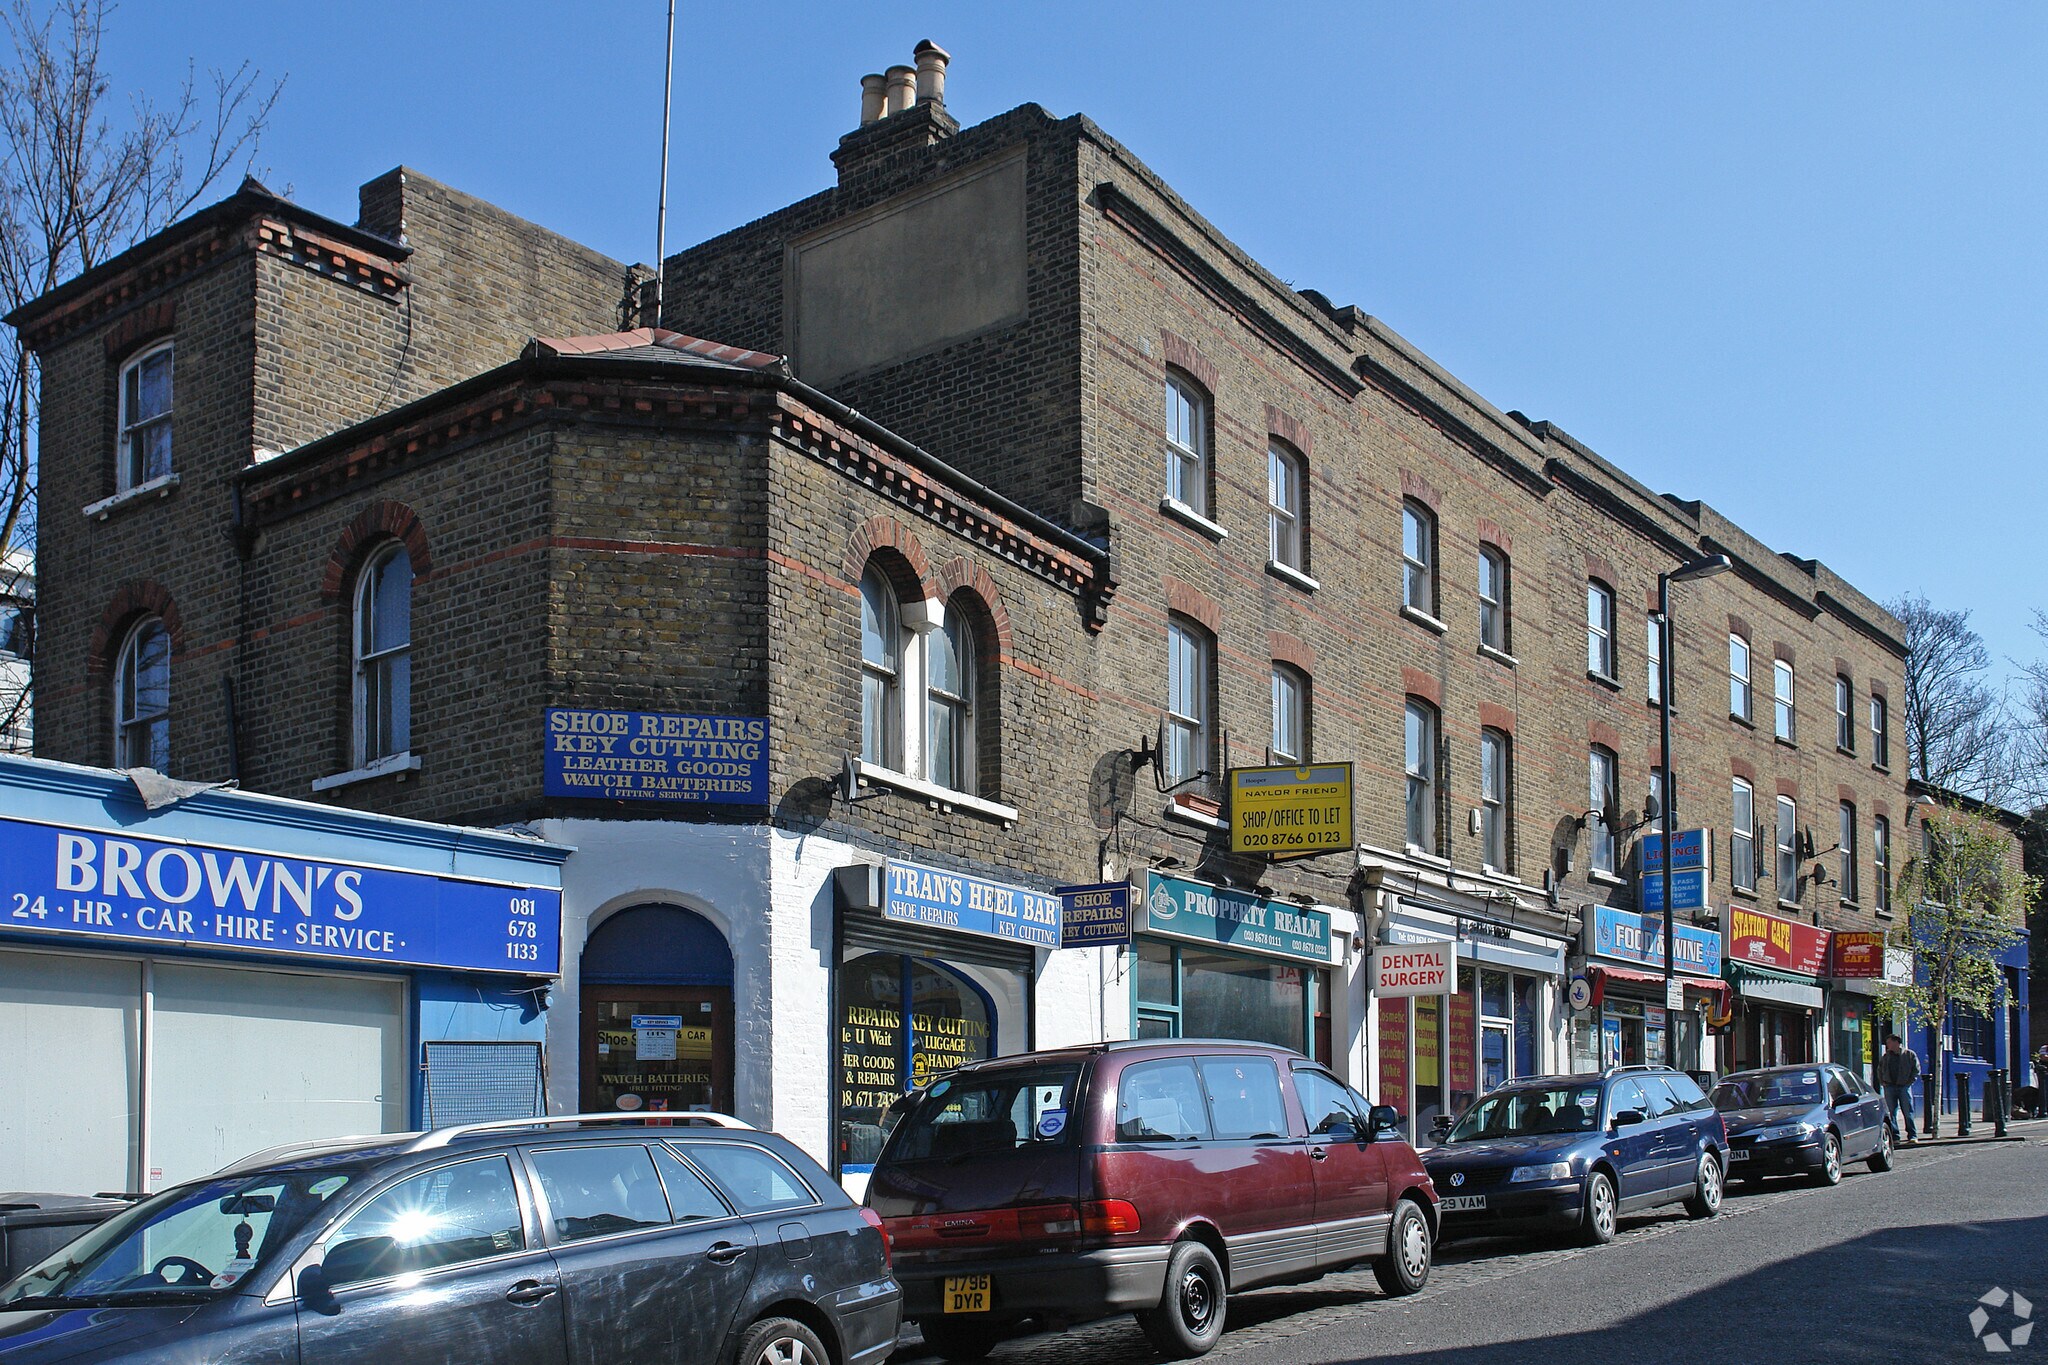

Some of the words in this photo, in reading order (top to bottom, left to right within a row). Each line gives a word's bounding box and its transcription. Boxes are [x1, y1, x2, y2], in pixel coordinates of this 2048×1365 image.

[551, 711, 629, 735] SHOE
[640, 715, 765, 741] REPAIRS
[554, 734, 618, 754] KEY
[629, 738, 760, 761] CUTTING
[563, 756, 668, 773] LEATHER
[677, 761, 751, 777] GOODS
[562, 772, 632, 788] WATCH
[642, 775, 752, 793] BATTERIES
[1245, 789, 1290, 797] NAYLOR
[1295, 787, 1338, 795] FRIEND
[1242, 808, 1304, 829] SHOP/OFFICE
[1308, 808, 1320, 825] TO
[1324, 807, 1341, 824] LET
[1243, 834, 1268, 846] 020
[1271, 833, 1304, 845] 8766
[1307, 831, 1341, 843] 0123
[56, 832, 363, 921] BROWN'S
[510, 897, 535, 916] 081
[968, 882, 1018, 918] HEEL
[1074, 892, 1112, 908] SHOE
[891, 900, 917, 918] SHOE
[920, 905, 959, 926] REPAIRS
[1063, 907, 1123, 923] REPAIRS
[1184, 890, 1268, 928] PROPERTY
[1274, 910, 1321, 939] REALM
[12, 893, 48, 919] 24
[73, 899, 114, 926] HR
[136, 907, 194, 934] CAR
[216, 915, 274, 942] HIRE
[296, 922, 394, 953] SERVICE
[508, 919, 537, 939] 678
[999, 920, 1017, 937] KEY
[1019, 925, 1056, 944] CUTTING
[1083, 922, 1126, 936] CUTTING
[1733, 910, 1768, 941] STATION
[1771, 920, 1790, 954] CAFE
[1268, 934, 1282, 947] 0111
[1615, 923, 1654, 953] FOOD
[1672, 938, 1704, 963] WINE
[506, 941, 538, 961] 1133
[1843, 955, 1871, 963] CAFE
[1382, 952, 1444, 970] DENTAL
[1380, 970, 1445, 987] SURGERY
[847, 1006, 900, 1029] REPAIRS
[938, 1016, 990, 1038] CUTTING
[1380, 1009, 1405, 1024] osmetic
[597, 1031, 628, 1046] Shoe
[687, 1030, 706, 1040] CAR
[855, 1028, 865, 1044] U
[869, 1029, 892, 1046] Wait
[925, 1035, 966, 1052] LUGGAGE
[969, 1041, 977, 1053] &
[863, 1054, 895, 1070] GOODS
[602, 1074, 643, 1084] WATCH
[648, 1073, 710, 1084] BATTERIES
[846, 1071, 855, 1084] &
[857, 1071, 895, 1086] REPAIRS
[856, 1091, 874, 1108] 671
[1441, 1198, 1456, 1210] 29
[1459, 1196, 1485, 1209] VAM
[944, 1219, 975, 1227] EMINA
[953, 1293, 983, 1310] DYR
